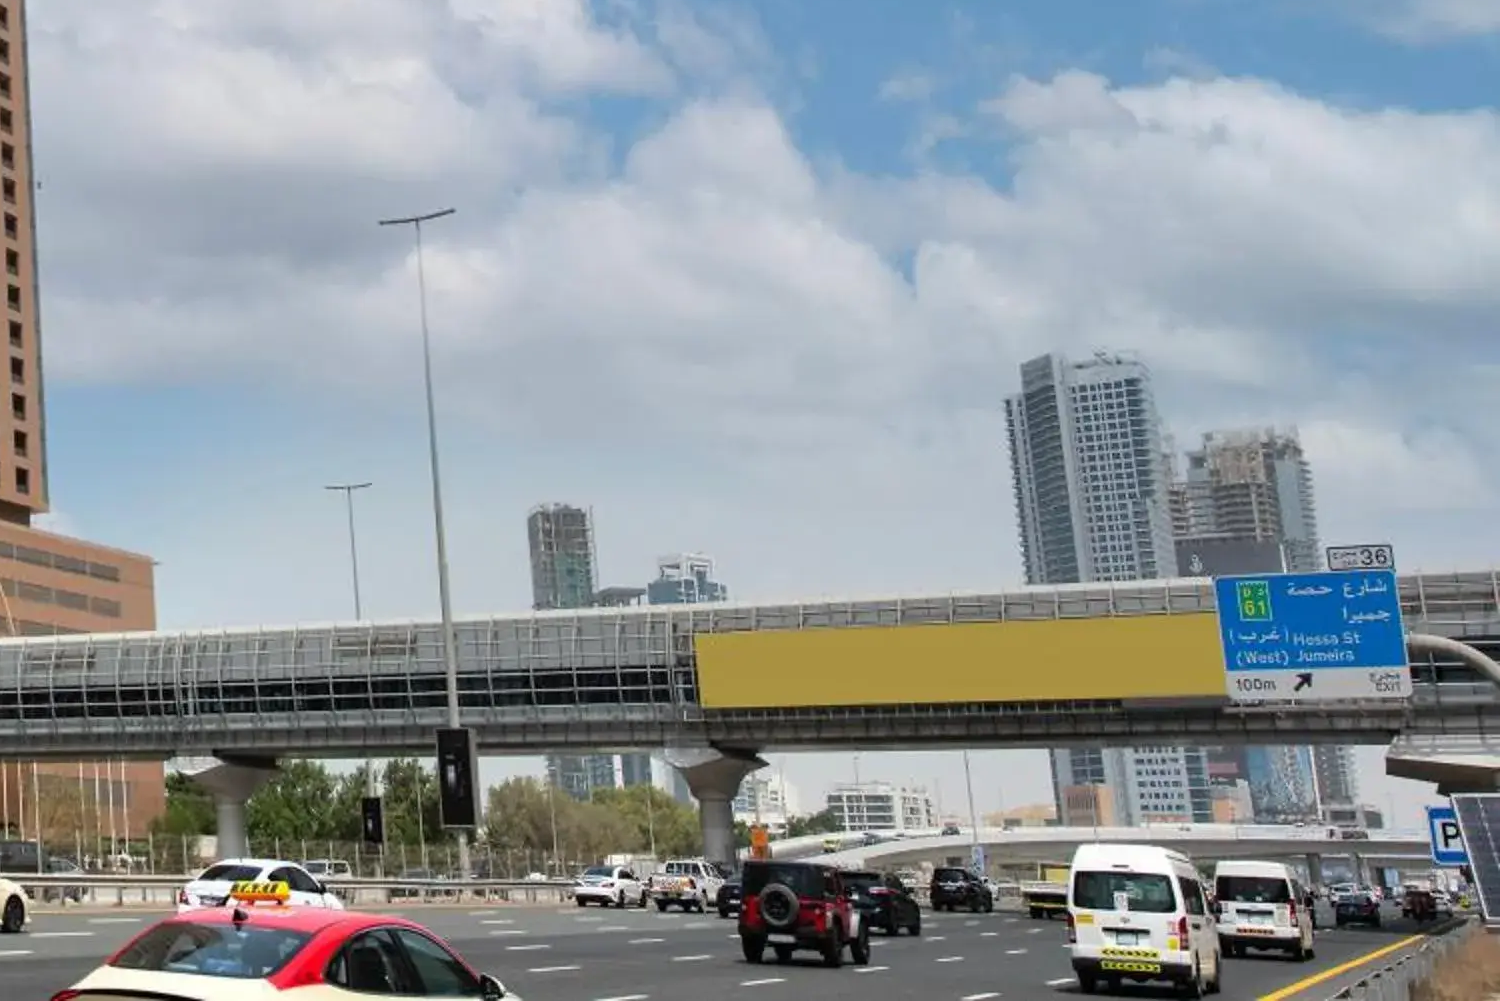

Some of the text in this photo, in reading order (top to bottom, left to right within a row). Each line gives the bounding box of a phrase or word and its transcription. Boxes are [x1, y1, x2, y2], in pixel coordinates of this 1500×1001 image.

[1360, 549, 1387, 565] 36
[1287, 577, 1387, 598] شارع حصة
[1244, 600, 1266, 616] 61
[1342, 605, 1391, 624] جميرا
[1343, 631, 1362, 644] St
[1236, 649, 1355, 666] (West) Jumeira
[1236, 678, 1277, 692] 100m
[1375, 682, 1402, 692] EXIT
[1441, 822, 1460, 849] P
